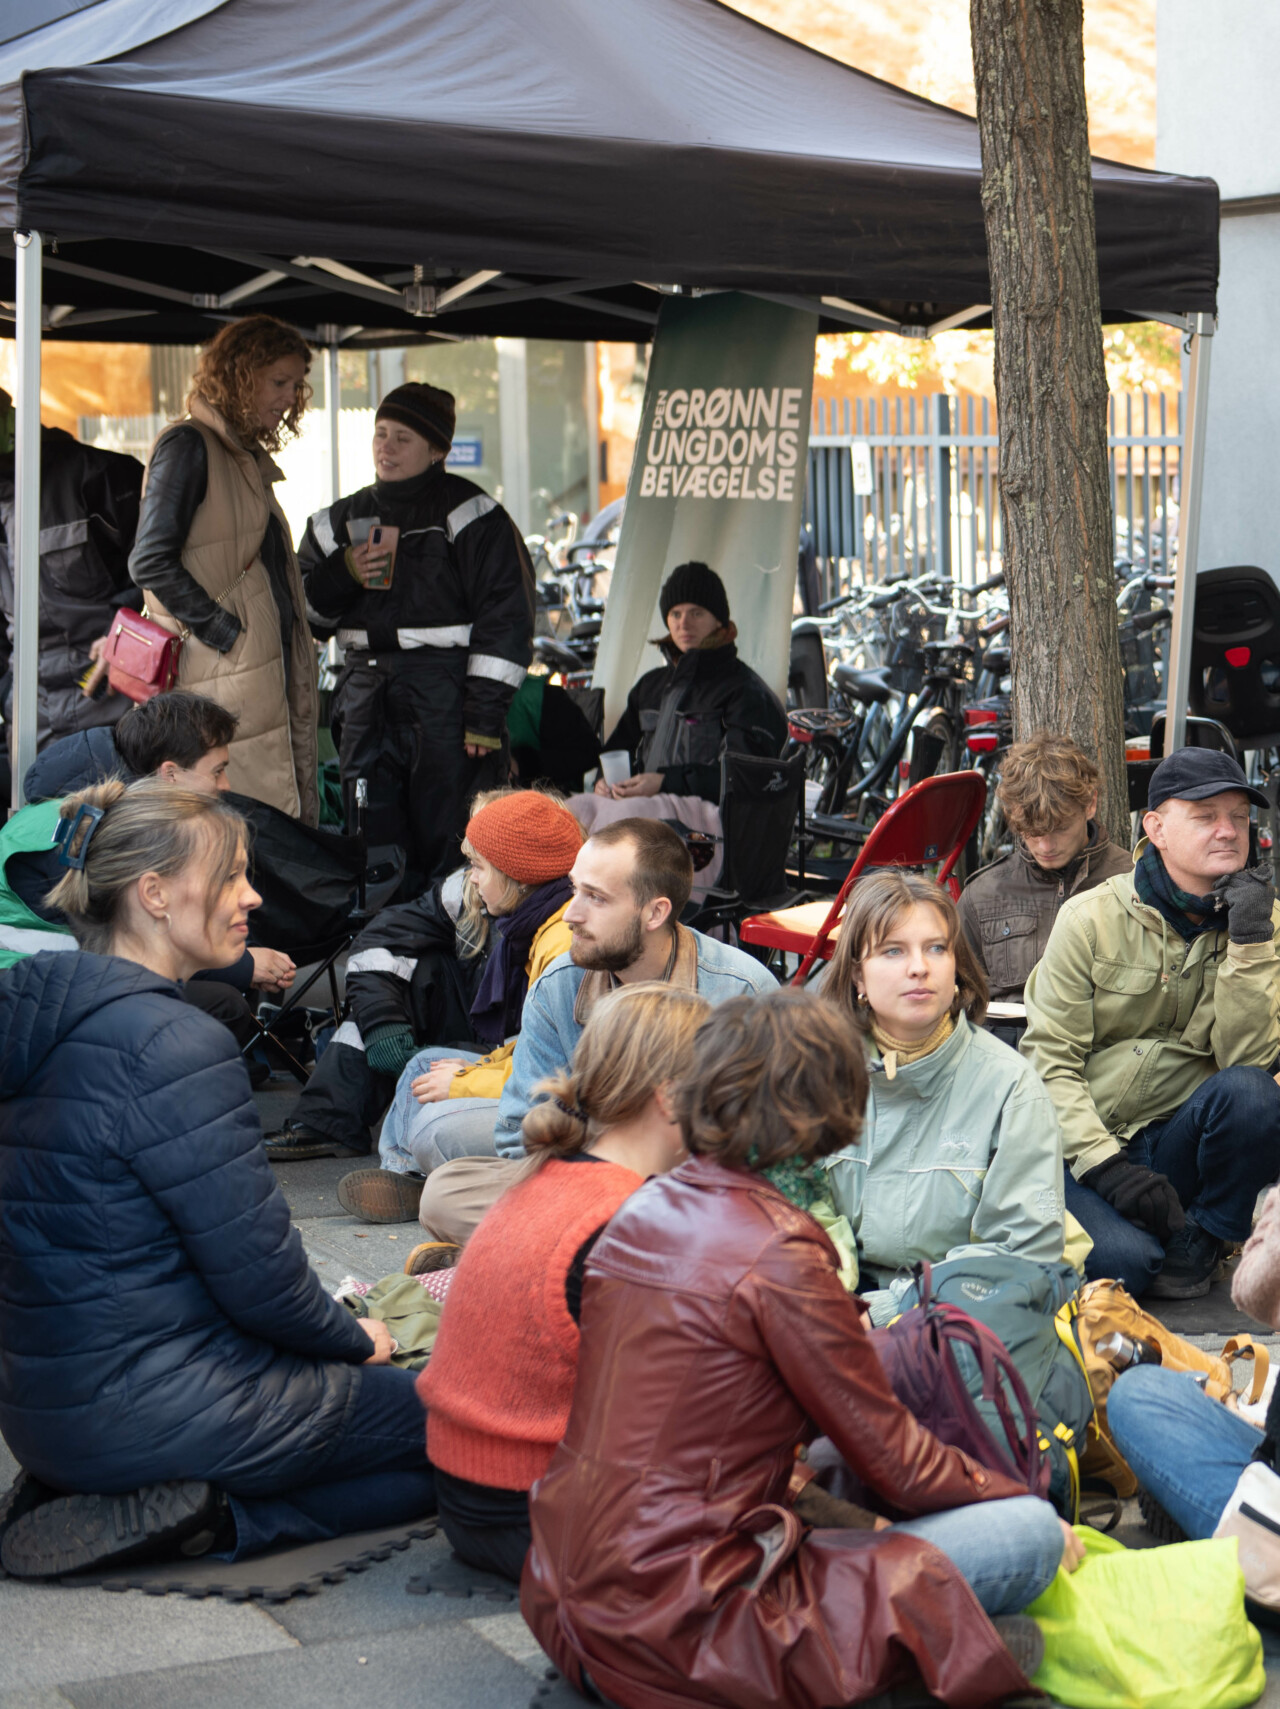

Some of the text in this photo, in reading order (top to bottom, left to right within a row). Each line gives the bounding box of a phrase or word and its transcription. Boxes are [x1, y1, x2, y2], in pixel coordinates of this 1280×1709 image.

[652, 387, 803, 430] DEN GRØNNE
[647, 429, 799, 468] UNGDOMS
[639, 465, 796, 502] BEVÆGELSE
